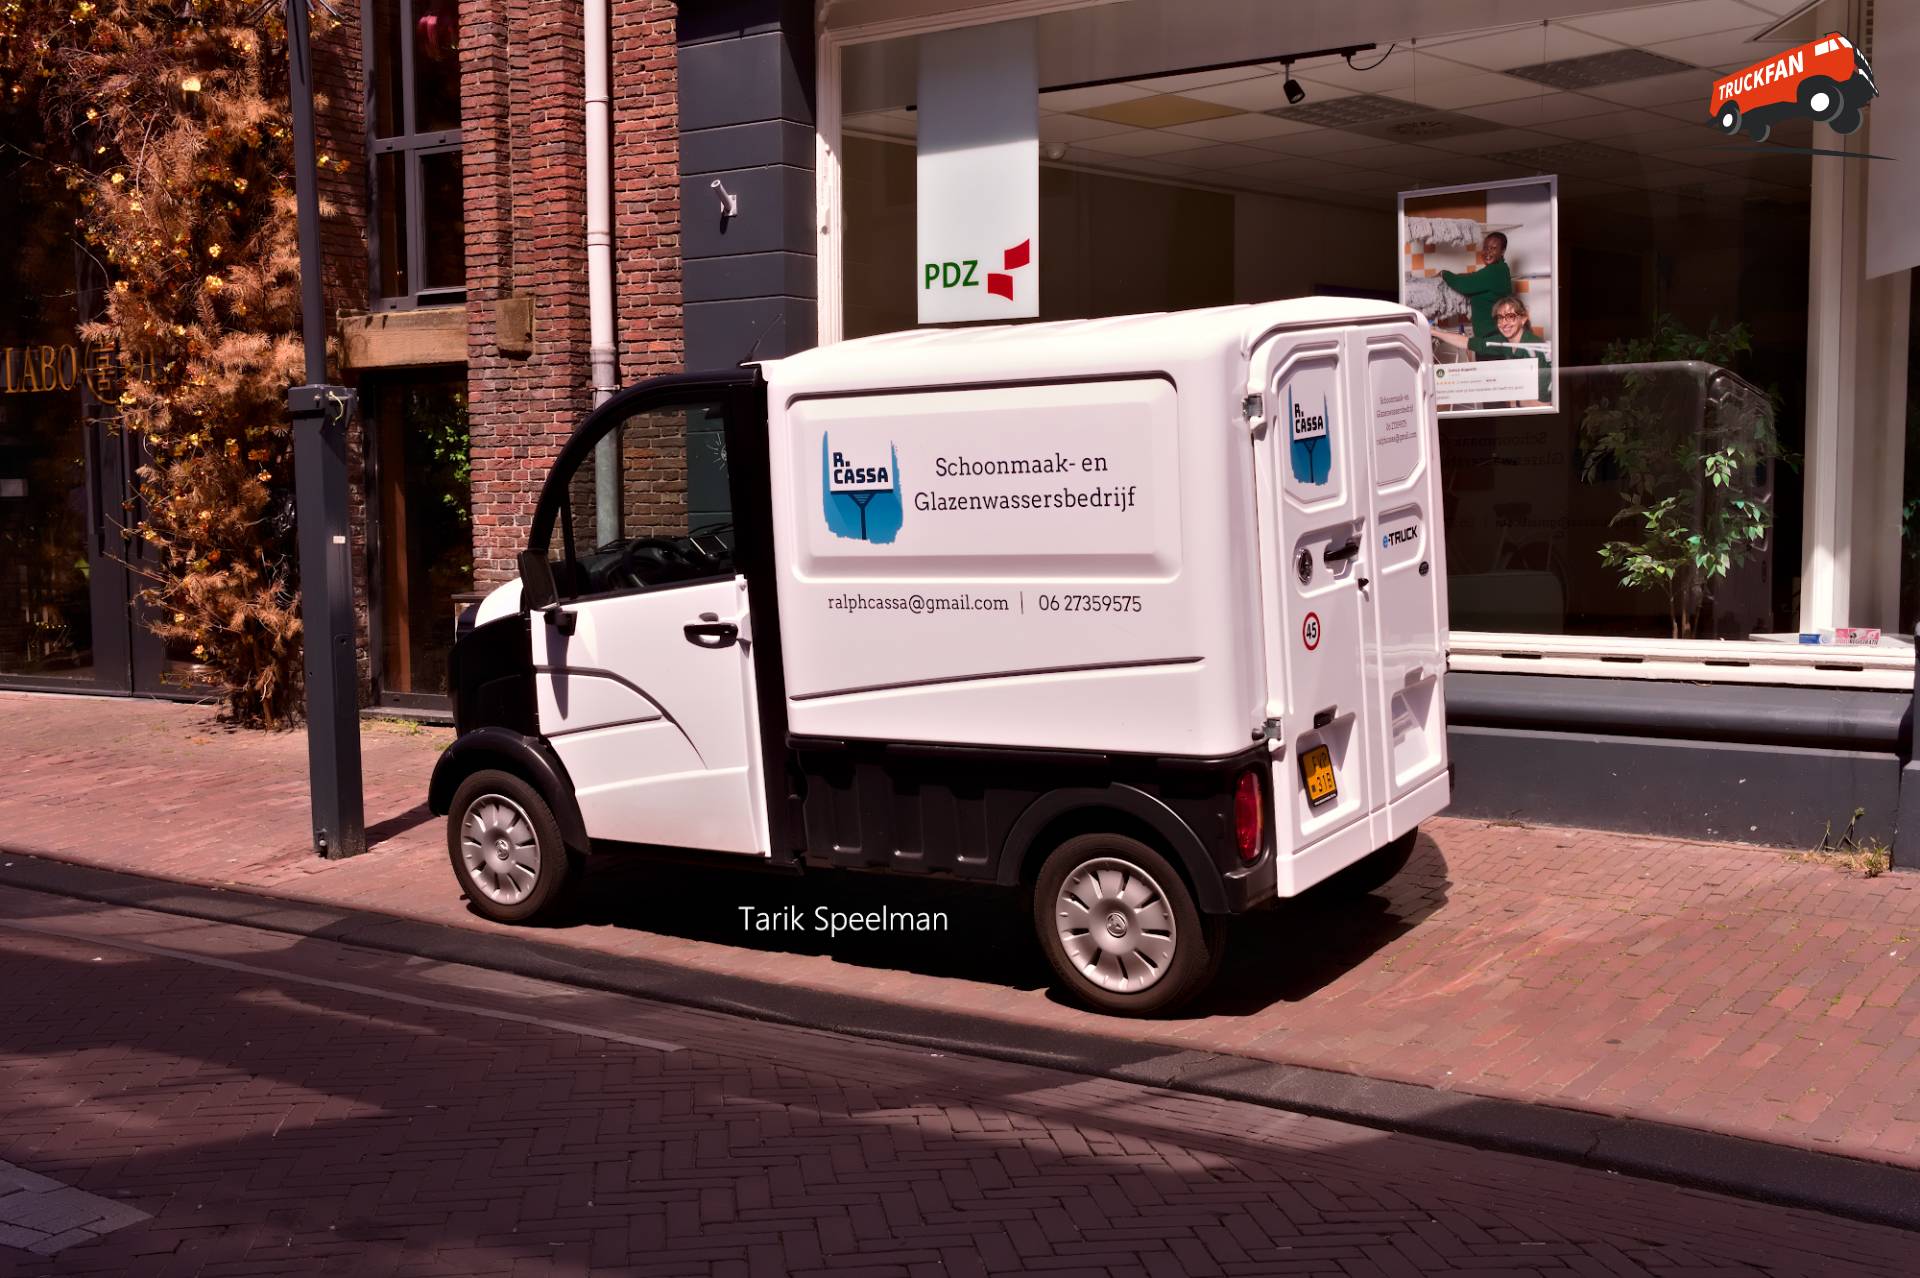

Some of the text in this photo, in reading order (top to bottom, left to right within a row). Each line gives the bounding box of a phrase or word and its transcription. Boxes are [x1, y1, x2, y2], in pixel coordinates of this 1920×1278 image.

[925, 260, 979, 289] PDZ
[4, 344, 77, 393] LABO
[1294, 403, 1304, 418] R.
[1295, 416, 1324, 433] CASSA
[833, 452, 850, 467] R.
[935, 452, 1108, 477] Schoonmaak- en
[833, 467, 889, 484] CASSA
[914, 486, 1137, 512] Glazenwassersbedrijf
[828, 594, 1142, 614] ralphcassa@gmail.com 06 27359575
[1306, 622, 1317, 639] 45
